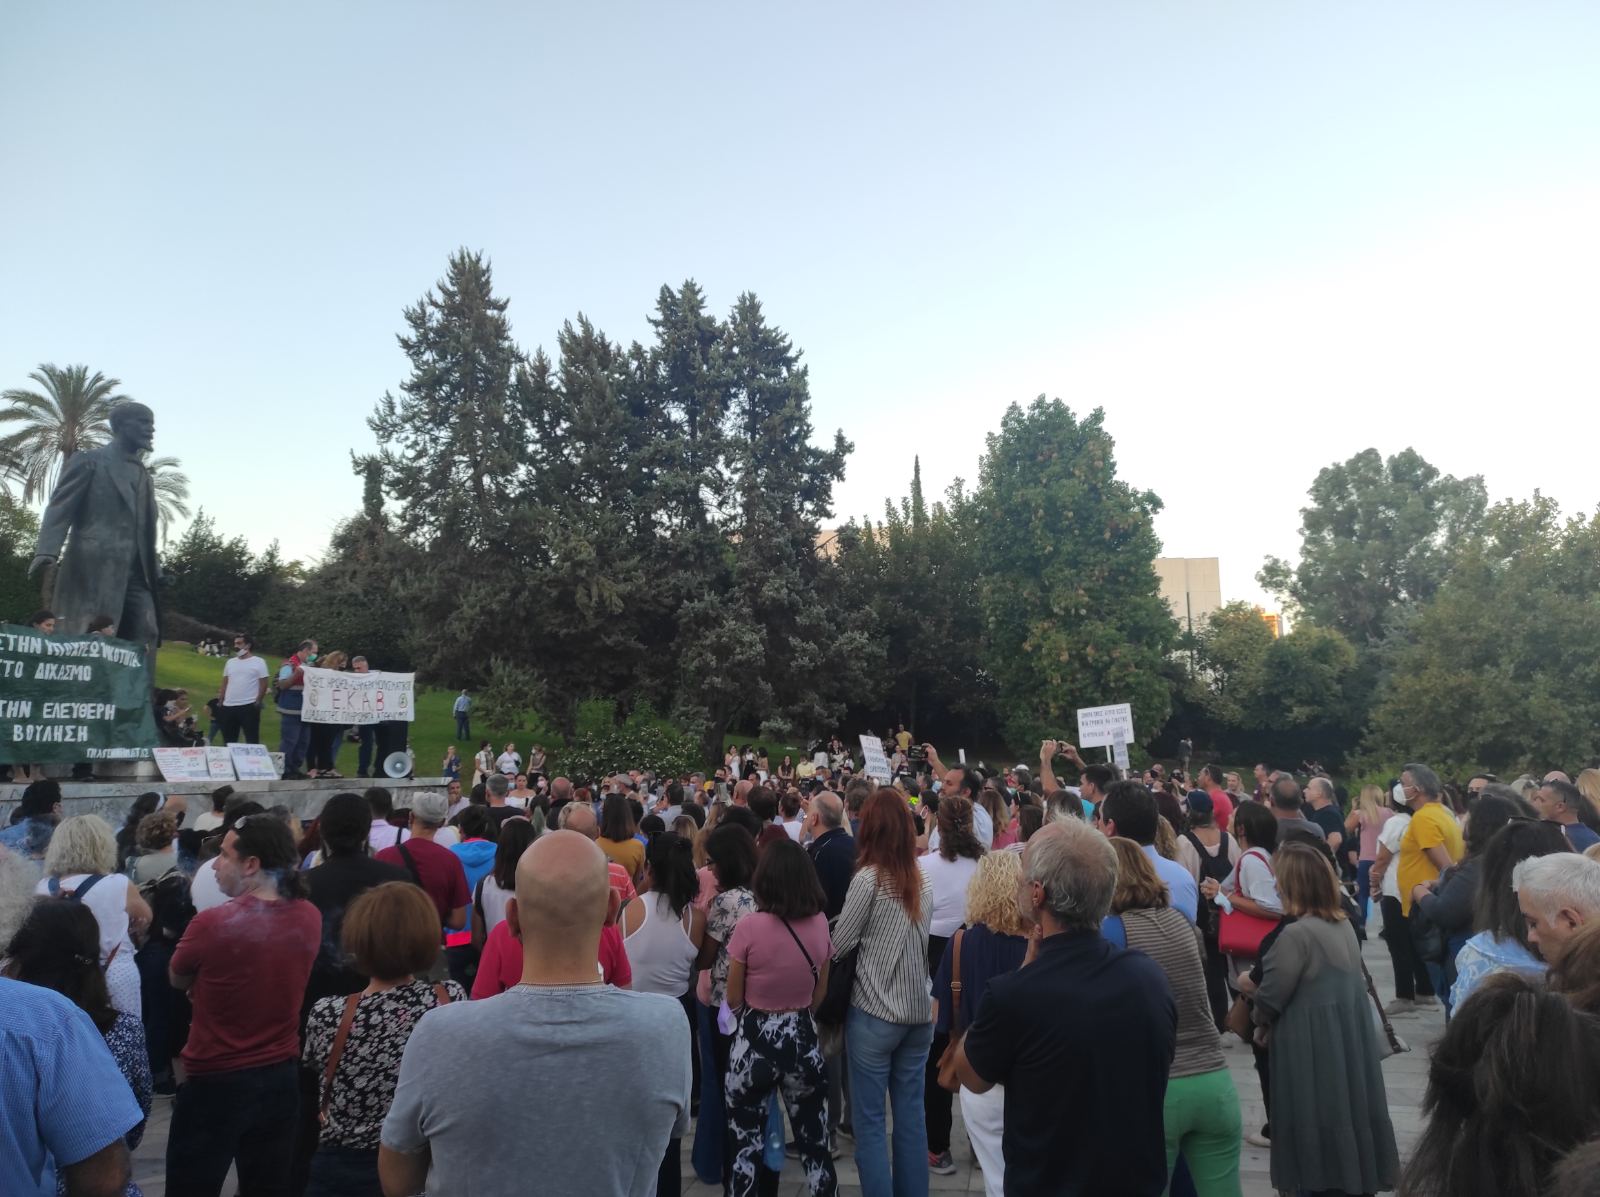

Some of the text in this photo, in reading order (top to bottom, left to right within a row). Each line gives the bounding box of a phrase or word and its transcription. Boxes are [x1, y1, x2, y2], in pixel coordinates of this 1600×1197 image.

[0, 659, 92, 682] ΤΟ ΔΙΧΑΣΜΟ
[42, 702, 116, 721] ΕΛΕΥΘΕΡΗ
[13, 724, 89, 742] ΒΟΥΛΗΣΗ
